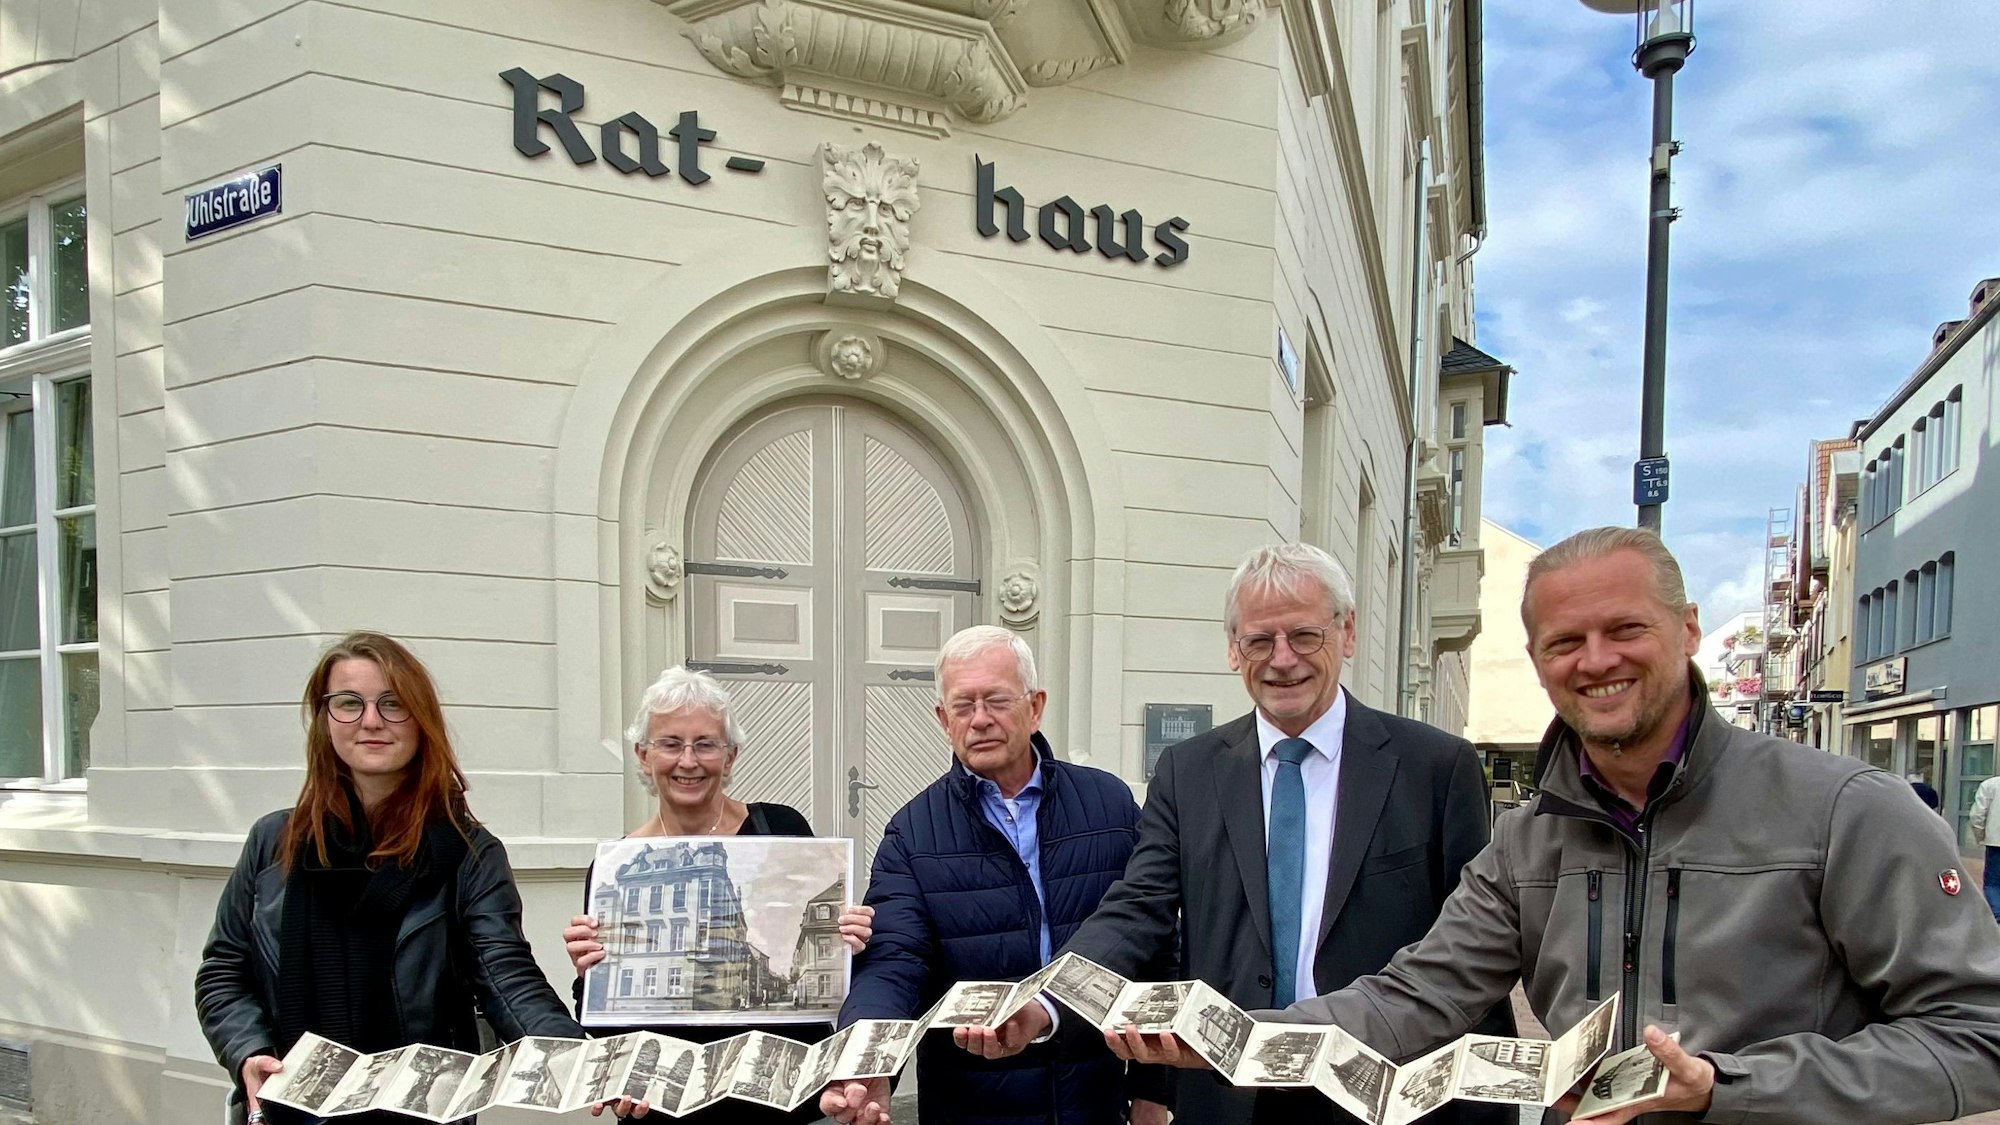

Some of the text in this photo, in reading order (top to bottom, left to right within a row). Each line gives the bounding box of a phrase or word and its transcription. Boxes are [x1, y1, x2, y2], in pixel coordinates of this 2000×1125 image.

[499, 66, 1190, 268] Rat- haus
[189, 174, 272, 227] Uhlstraße
[1643, 465, 1651, 476] S
